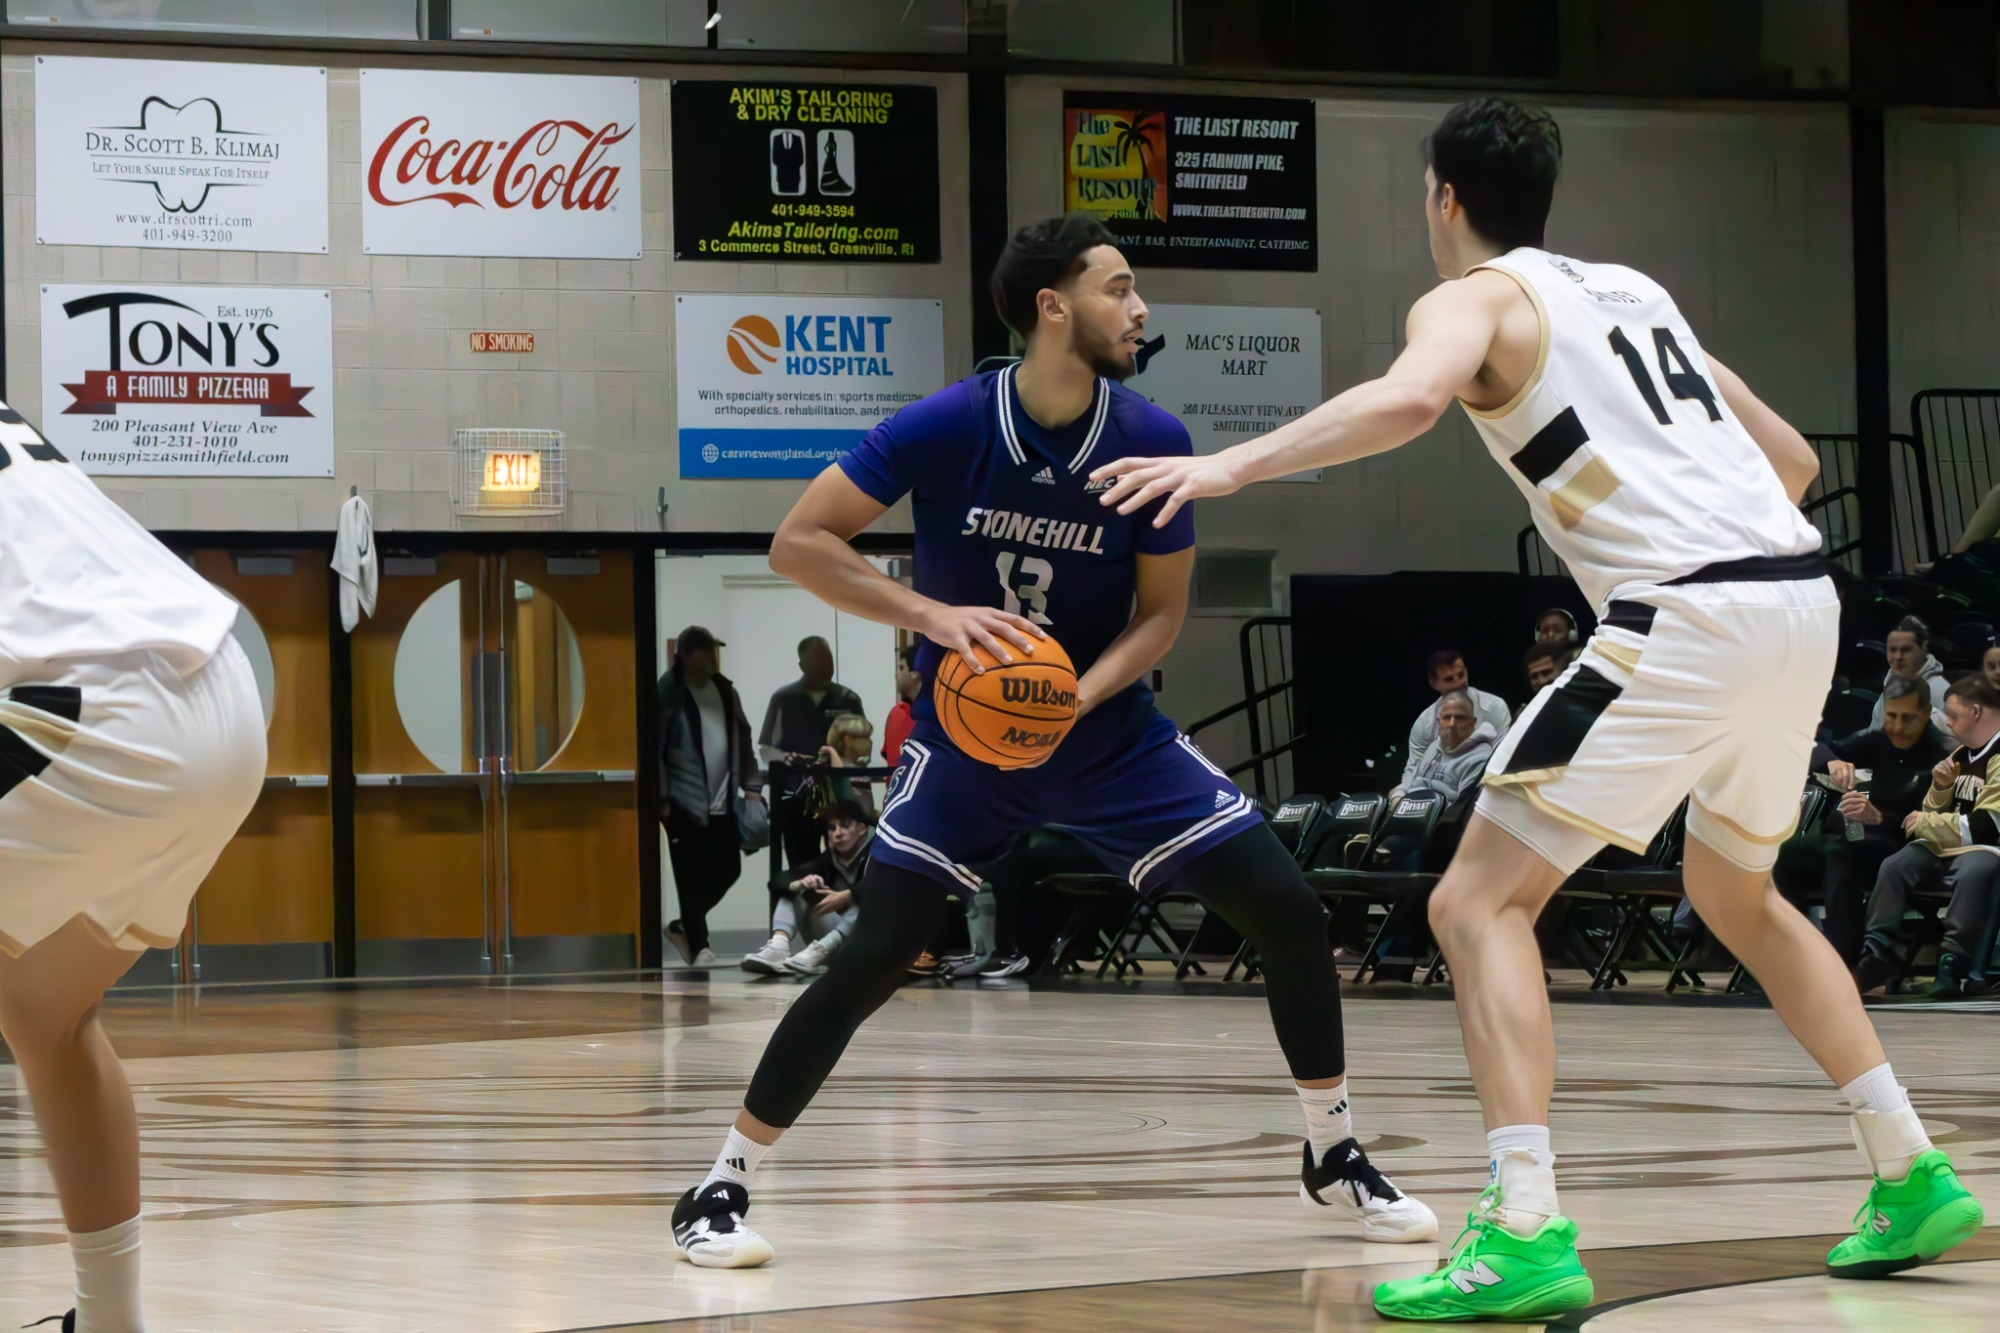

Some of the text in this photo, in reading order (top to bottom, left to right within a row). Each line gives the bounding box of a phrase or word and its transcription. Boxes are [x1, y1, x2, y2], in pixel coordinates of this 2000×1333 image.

[729, 88, 893, 108] AKIM'S TAILORING
[736, 104, 889, 124] & DRY CLEANING
[1174, 116, 1300, 140] THE LAST RESORT
[190, 136, 208, 155] B.
[367, 115, 637, 211] Coca-Cola
[1174, 152, 1201, 168] 325
[1255, 154, 1284, 172] PIKE,
[1174, 172, 1248, 190] SMITHFIELD
[116, 212, 253, 227] www.drscottri.com
[771, 203, 855, 218] 401-949-3594
[142, 228, 233, 243] 401-949-3200
[728, 220, 899, 243] AkimsTailoring.com
[698, 239, 707, 252] 3
[710, 239, 780, 253] Commerce
[784, 241, 826, 256] Street,
[1258, 239, 1310, 250] CATERING
[217, 305, 273, 320] Est. 1976
[62, 292, 280, 372] TONY'S
[785, 314, 893, 353] KENT
[471, 333, 533, 351] NO SMOKING
[1186, 333, 1301, 356] MAC'S LIQUOR
[785, 355, 895, 377] HOSPITAL
[1221, 359, 1268, 376] MART
[1607, 325, 1724, 426] 14
[105, 374, 270, 400] A FAMILY PIZZERIA
[698, 389, 724, 401] With
[725, 390, 774, 404] specialty
[776, 391, 822, 402] services
[839, 392, 875, 404] sports
[860, 405, 880, 416] and
[1199, 404, 1254, 416] PLEASANT
[1257, 405, 1283, 416] VIEW
[91, 418, 278, 435] 200 Pleasant View Ave
[132, 434, 238, 448] 401-231-1010
[80, 448, 289, 466] tonyspizzasmithfield.com
[492, 453, 532, 485] EXIT
[1031, 476, 1056, 485] adidas
[1083, 478, 1115, 491] NEC
[961, 507, 1104, 555] STONEHILL
[996, 551, 1054, 626] 13
[1000, 677, 1076, 708] Wilson
[1276, 806, 1308, 819] BRYANT
[1340, 802, 1375, 816] BRYANT
[1397, 801, 1432, 815] BRYANT
